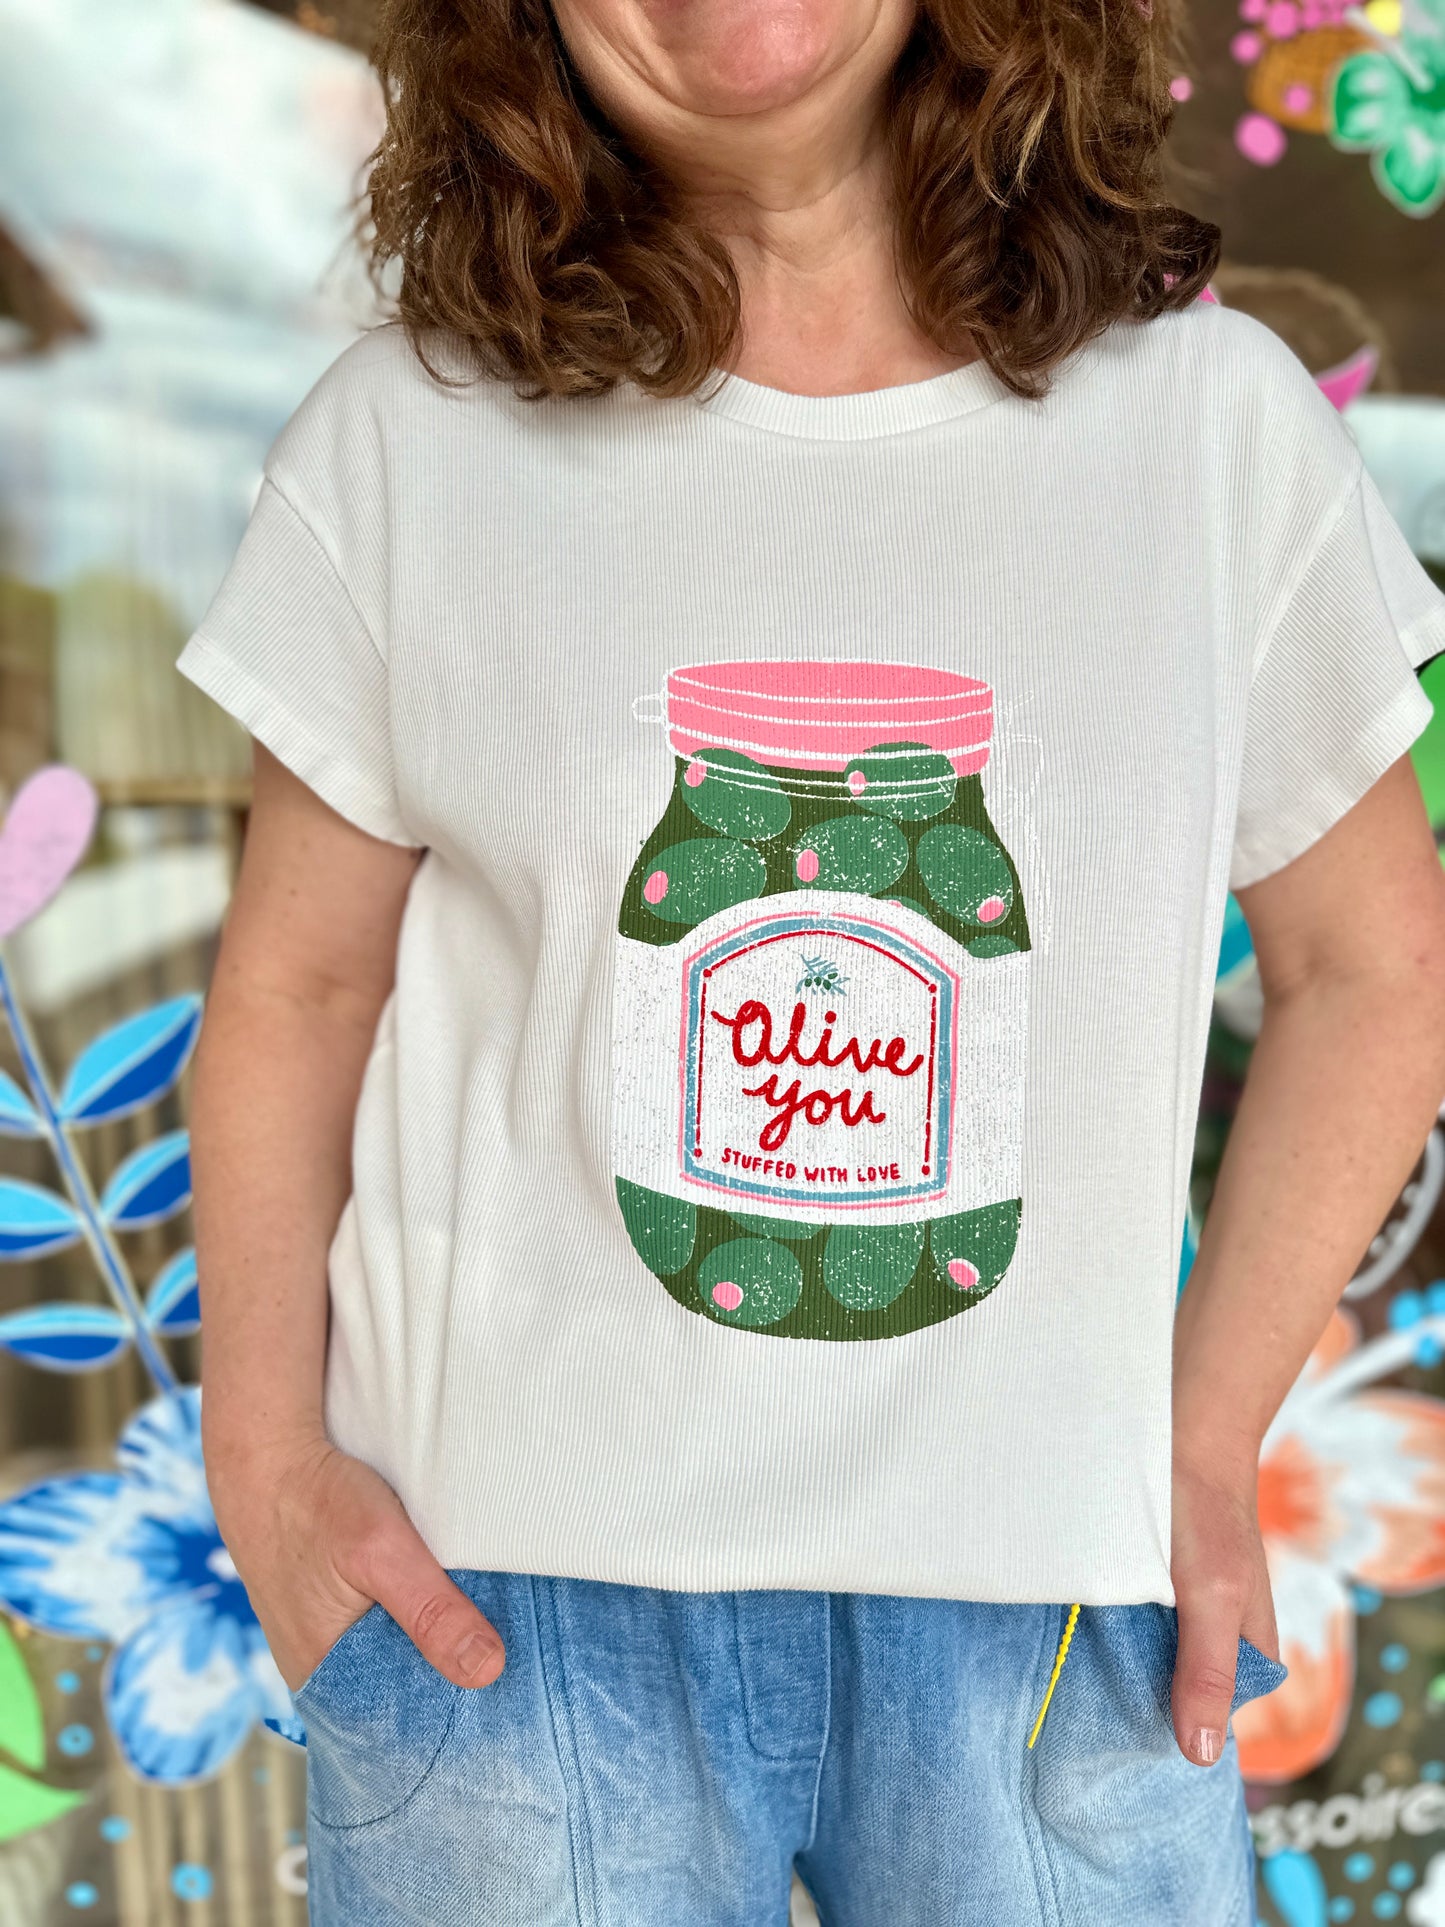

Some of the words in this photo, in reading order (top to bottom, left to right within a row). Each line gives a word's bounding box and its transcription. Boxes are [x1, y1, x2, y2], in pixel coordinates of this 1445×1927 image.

[741, 1073, 886, 1152] you
[721, 1147, 797, 1180] STUFFED
[804, 1166, 848, 1182] WITH
[857, 1163, 901, 1182] LOVE
